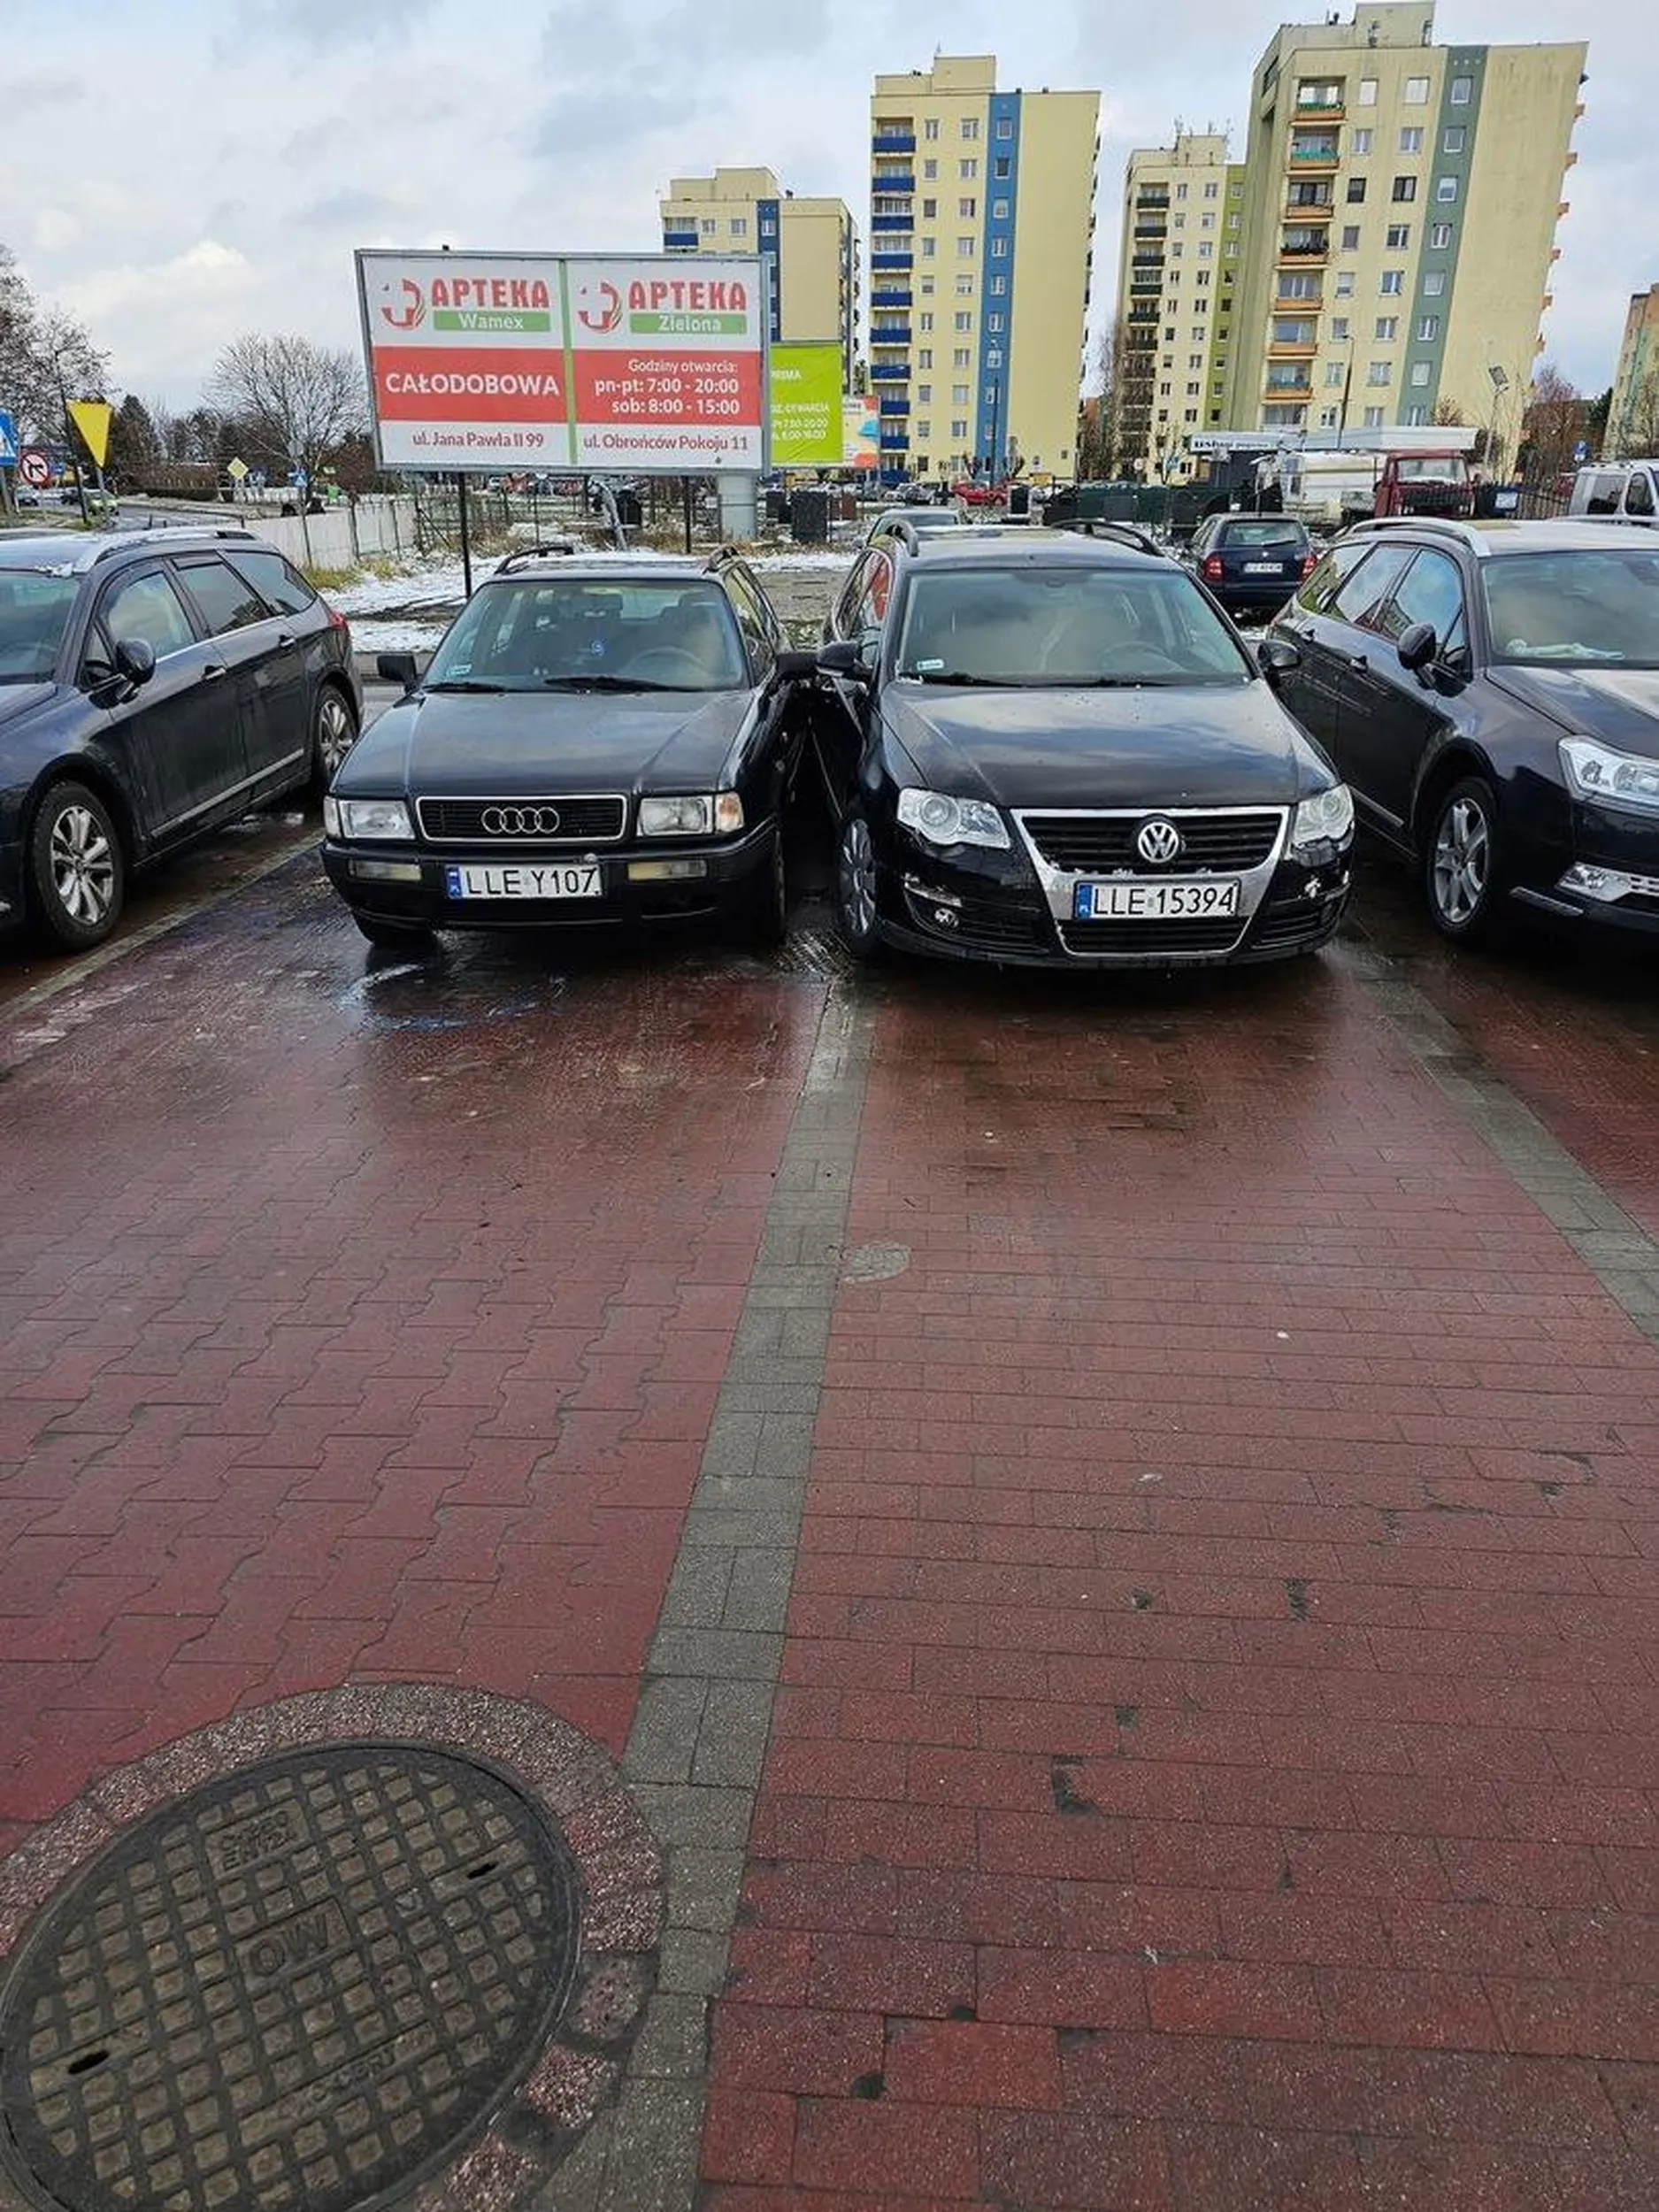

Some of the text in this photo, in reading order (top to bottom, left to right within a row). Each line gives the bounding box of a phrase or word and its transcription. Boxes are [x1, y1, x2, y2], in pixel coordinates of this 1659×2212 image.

[431, 278, 550, 308] APTEKA
[629, 280, 747, 310] APTEKA
[458, 312, 525, 330] Wamex
[658, 314, 722, 332] Zielona
[628, 359, 738, 374] Godziny otwarcia:
[386, 373, 559, 396] CAŁODOBOWA
[595, 379, 644, 396] pn-pt:
[648, 379, 681, 393] 7:00
[695, 379, 739, 394] 20:00
[612, 397, 646, 413] sob:
[649, 399, 683, 413] 8:00
[697, 399, 740, 414] 15:00
[413, 433, 431, 445] ul.
[433, 432, 464, 446] Jana
[467, 432, 511, 446] Pawła
[526, 434, 544, 447] 99
[584, 434, 748, 452] ul. Obrońców Pokoju 11
[466, 870, 522, 895] LLE
[531, 867, 597, 895] Y107
[1094, 886, 1234, 915] LLE 15394
